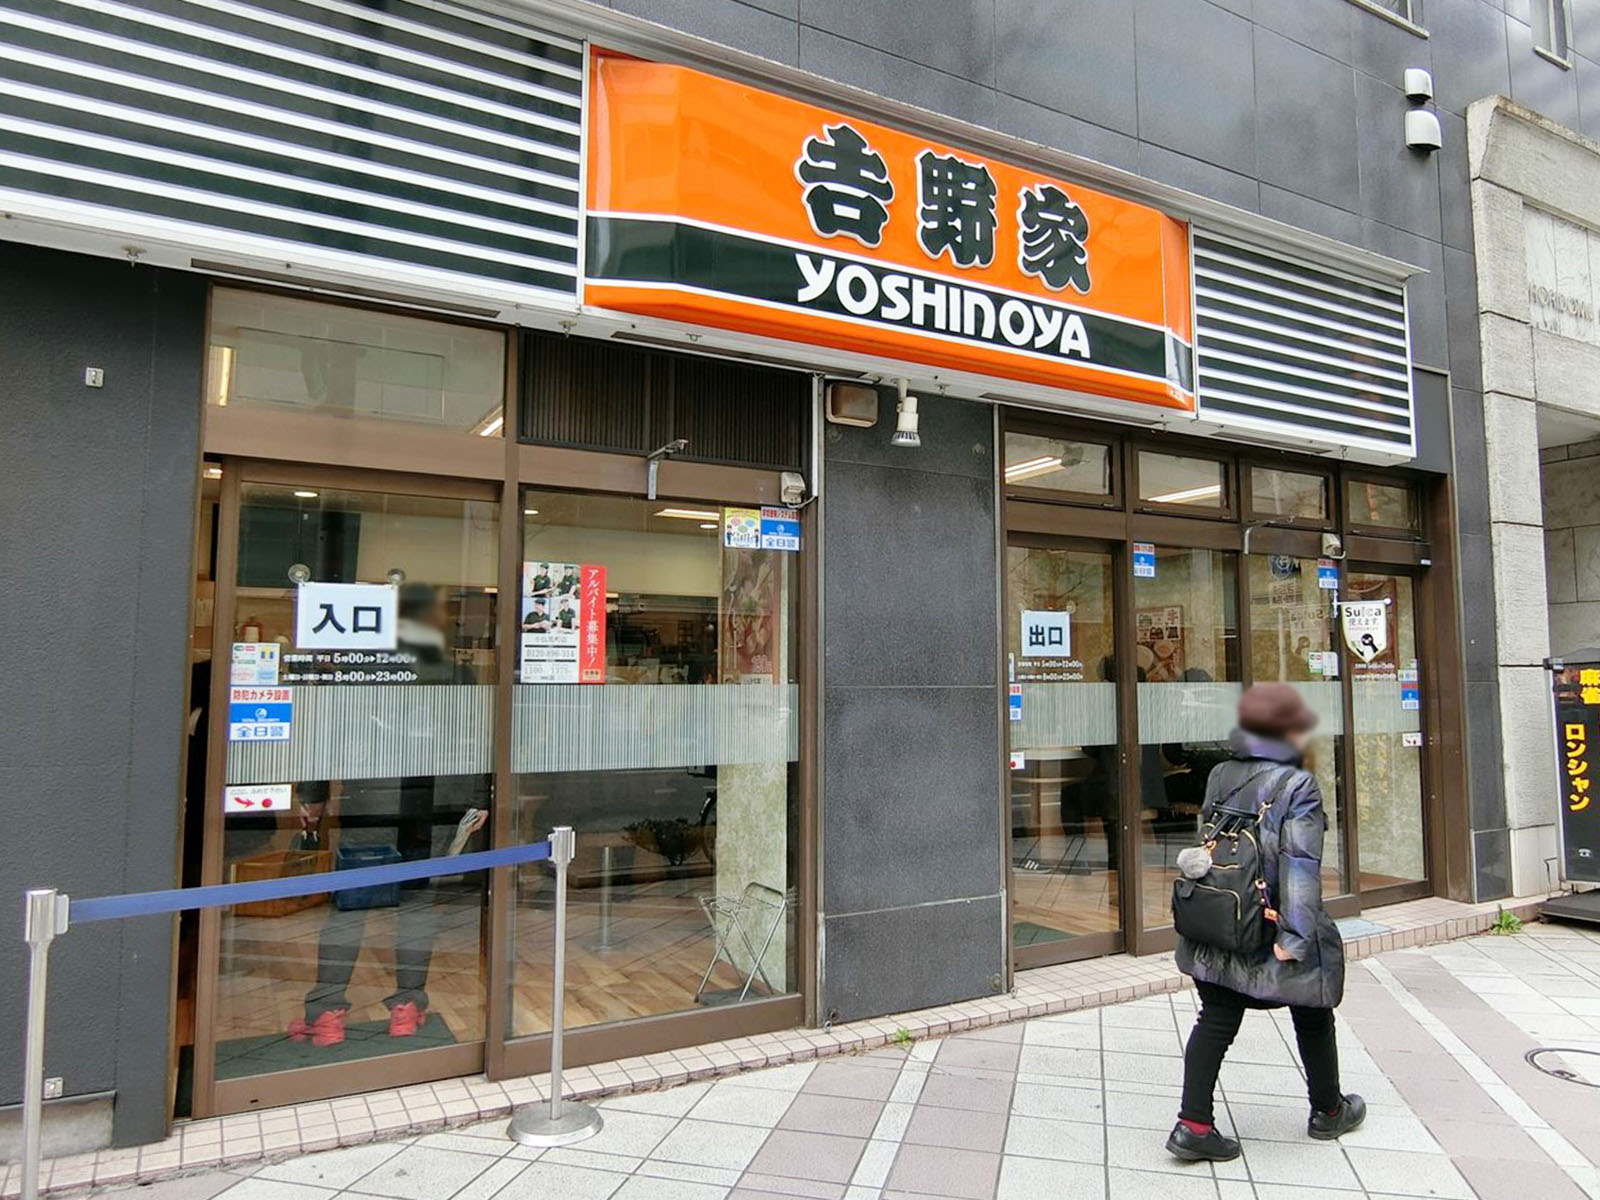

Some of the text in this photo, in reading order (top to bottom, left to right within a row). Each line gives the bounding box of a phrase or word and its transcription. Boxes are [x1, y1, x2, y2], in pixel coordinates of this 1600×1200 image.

[795, 253, 1091, 359] YOSHINOYA
[312, 603, 382, 634] 入口
[1345, 606, 1382, 618] Suica
[1029, 624, 1063, 647] 出口
[1565, 723, 1590, 811] ロンシャン
